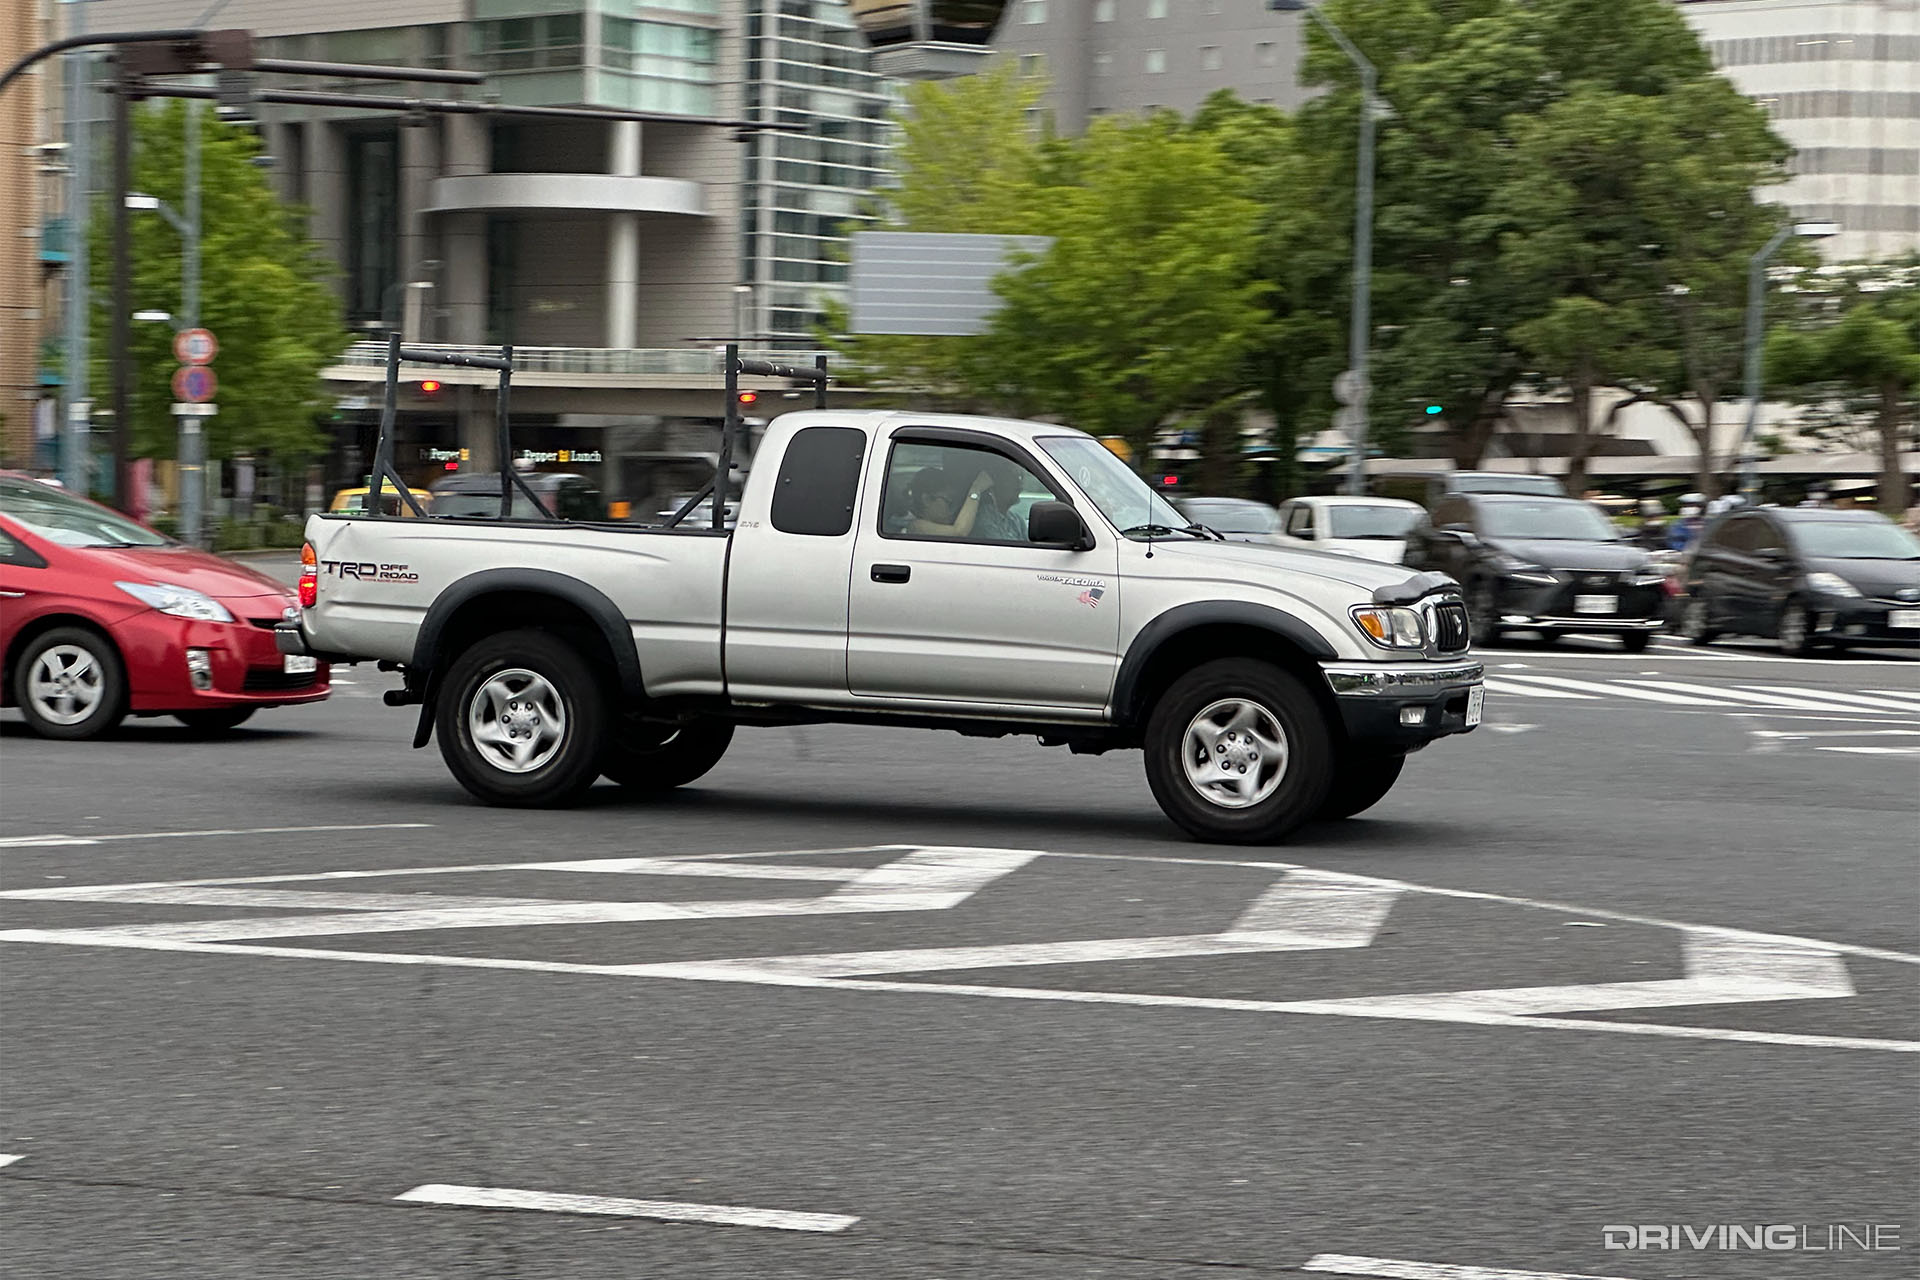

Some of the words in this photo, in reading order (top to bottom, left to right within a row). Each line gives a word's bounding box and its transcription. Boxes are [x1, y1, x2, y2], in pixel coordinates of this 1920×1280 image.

[523, 449, 558, 462] Pepper
[570, 450, 602, 462] Lunch
[321, 560, 377, 580] TRD
[380, 572, 419, 580] ROAD
[1061, 577, 1105, 588] TACOMA
